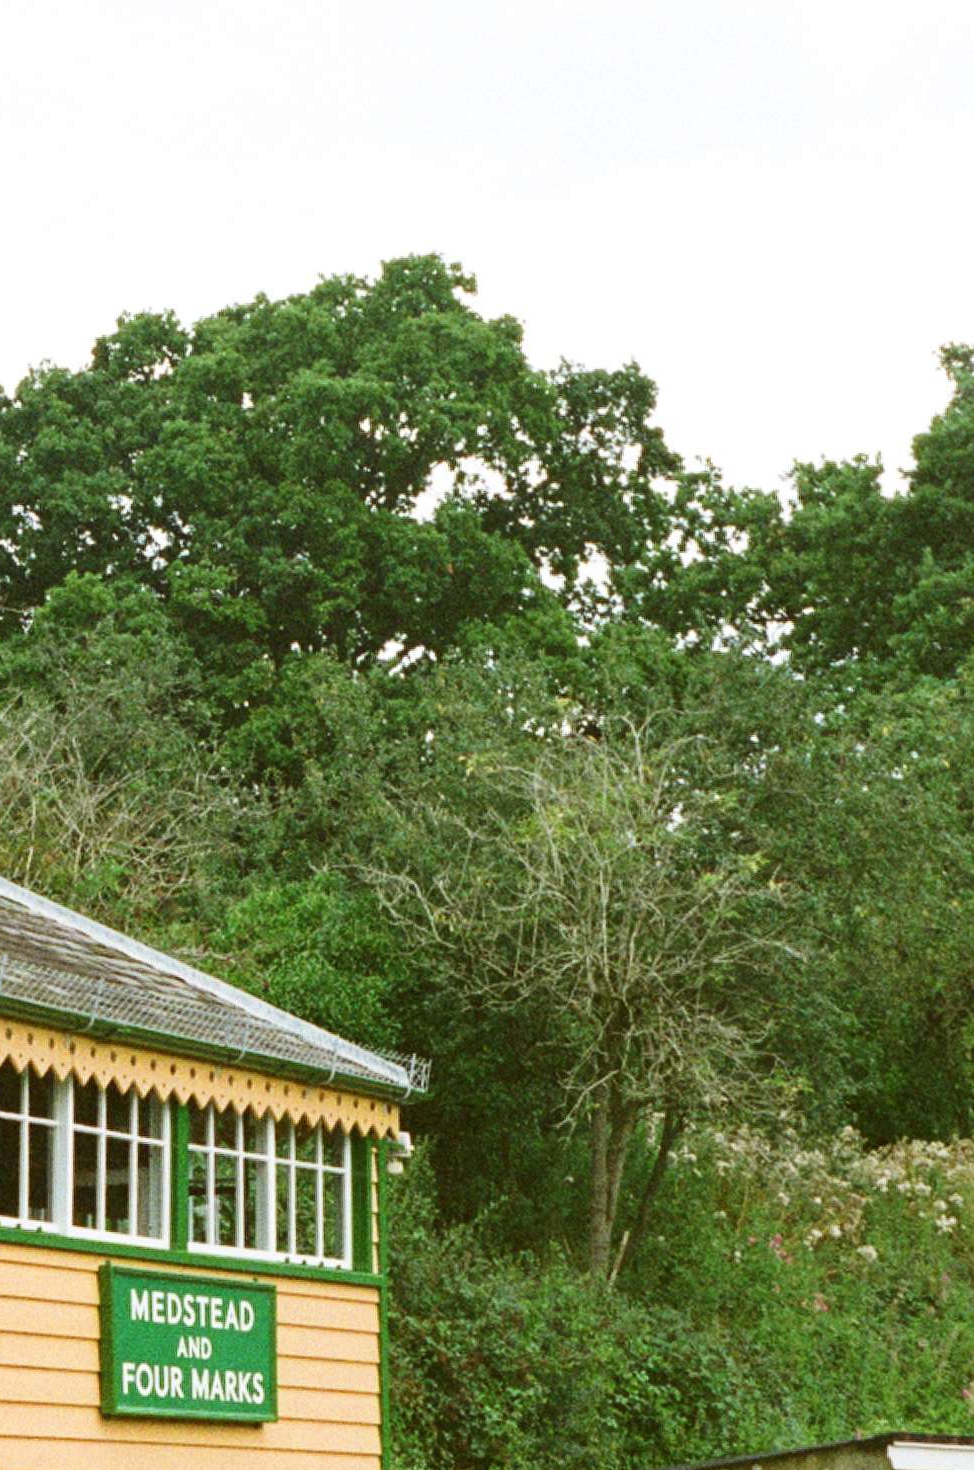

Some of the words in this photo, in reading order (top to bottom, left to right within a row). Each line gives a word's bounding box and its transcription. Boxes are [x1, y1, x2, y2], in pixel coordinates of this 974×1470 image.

[130, 1288, 255, 1332] MEDSTEAD
[177, 1336, 212, 1360] AND
[122, 1362, 184, 1399] FOUR
[191, 1368, 265, 1405] MARKS
